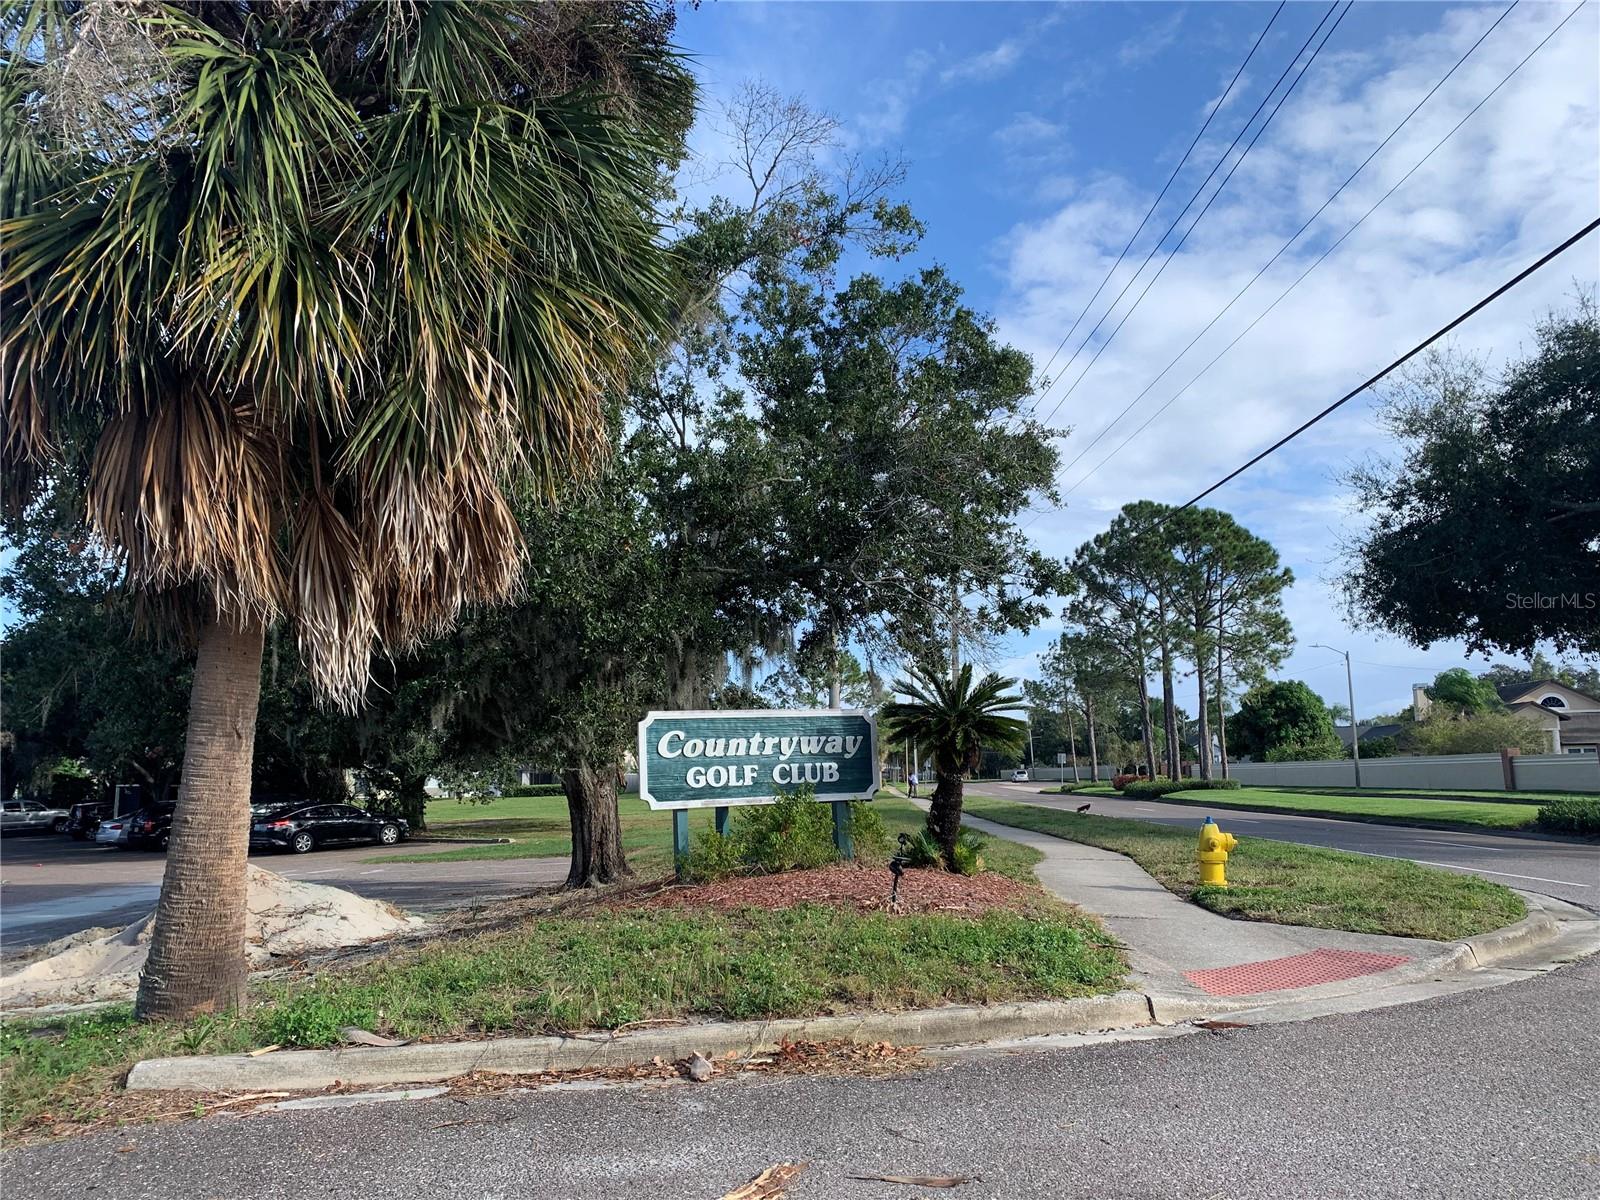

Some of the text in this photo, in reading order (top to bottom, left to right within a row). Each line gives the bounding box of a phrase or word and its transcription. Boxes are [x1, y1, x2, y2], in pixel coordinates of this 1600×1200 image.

[657, 730, 864, 761] Countryway
[686, 762, 840, 788] GOLF CLUB
